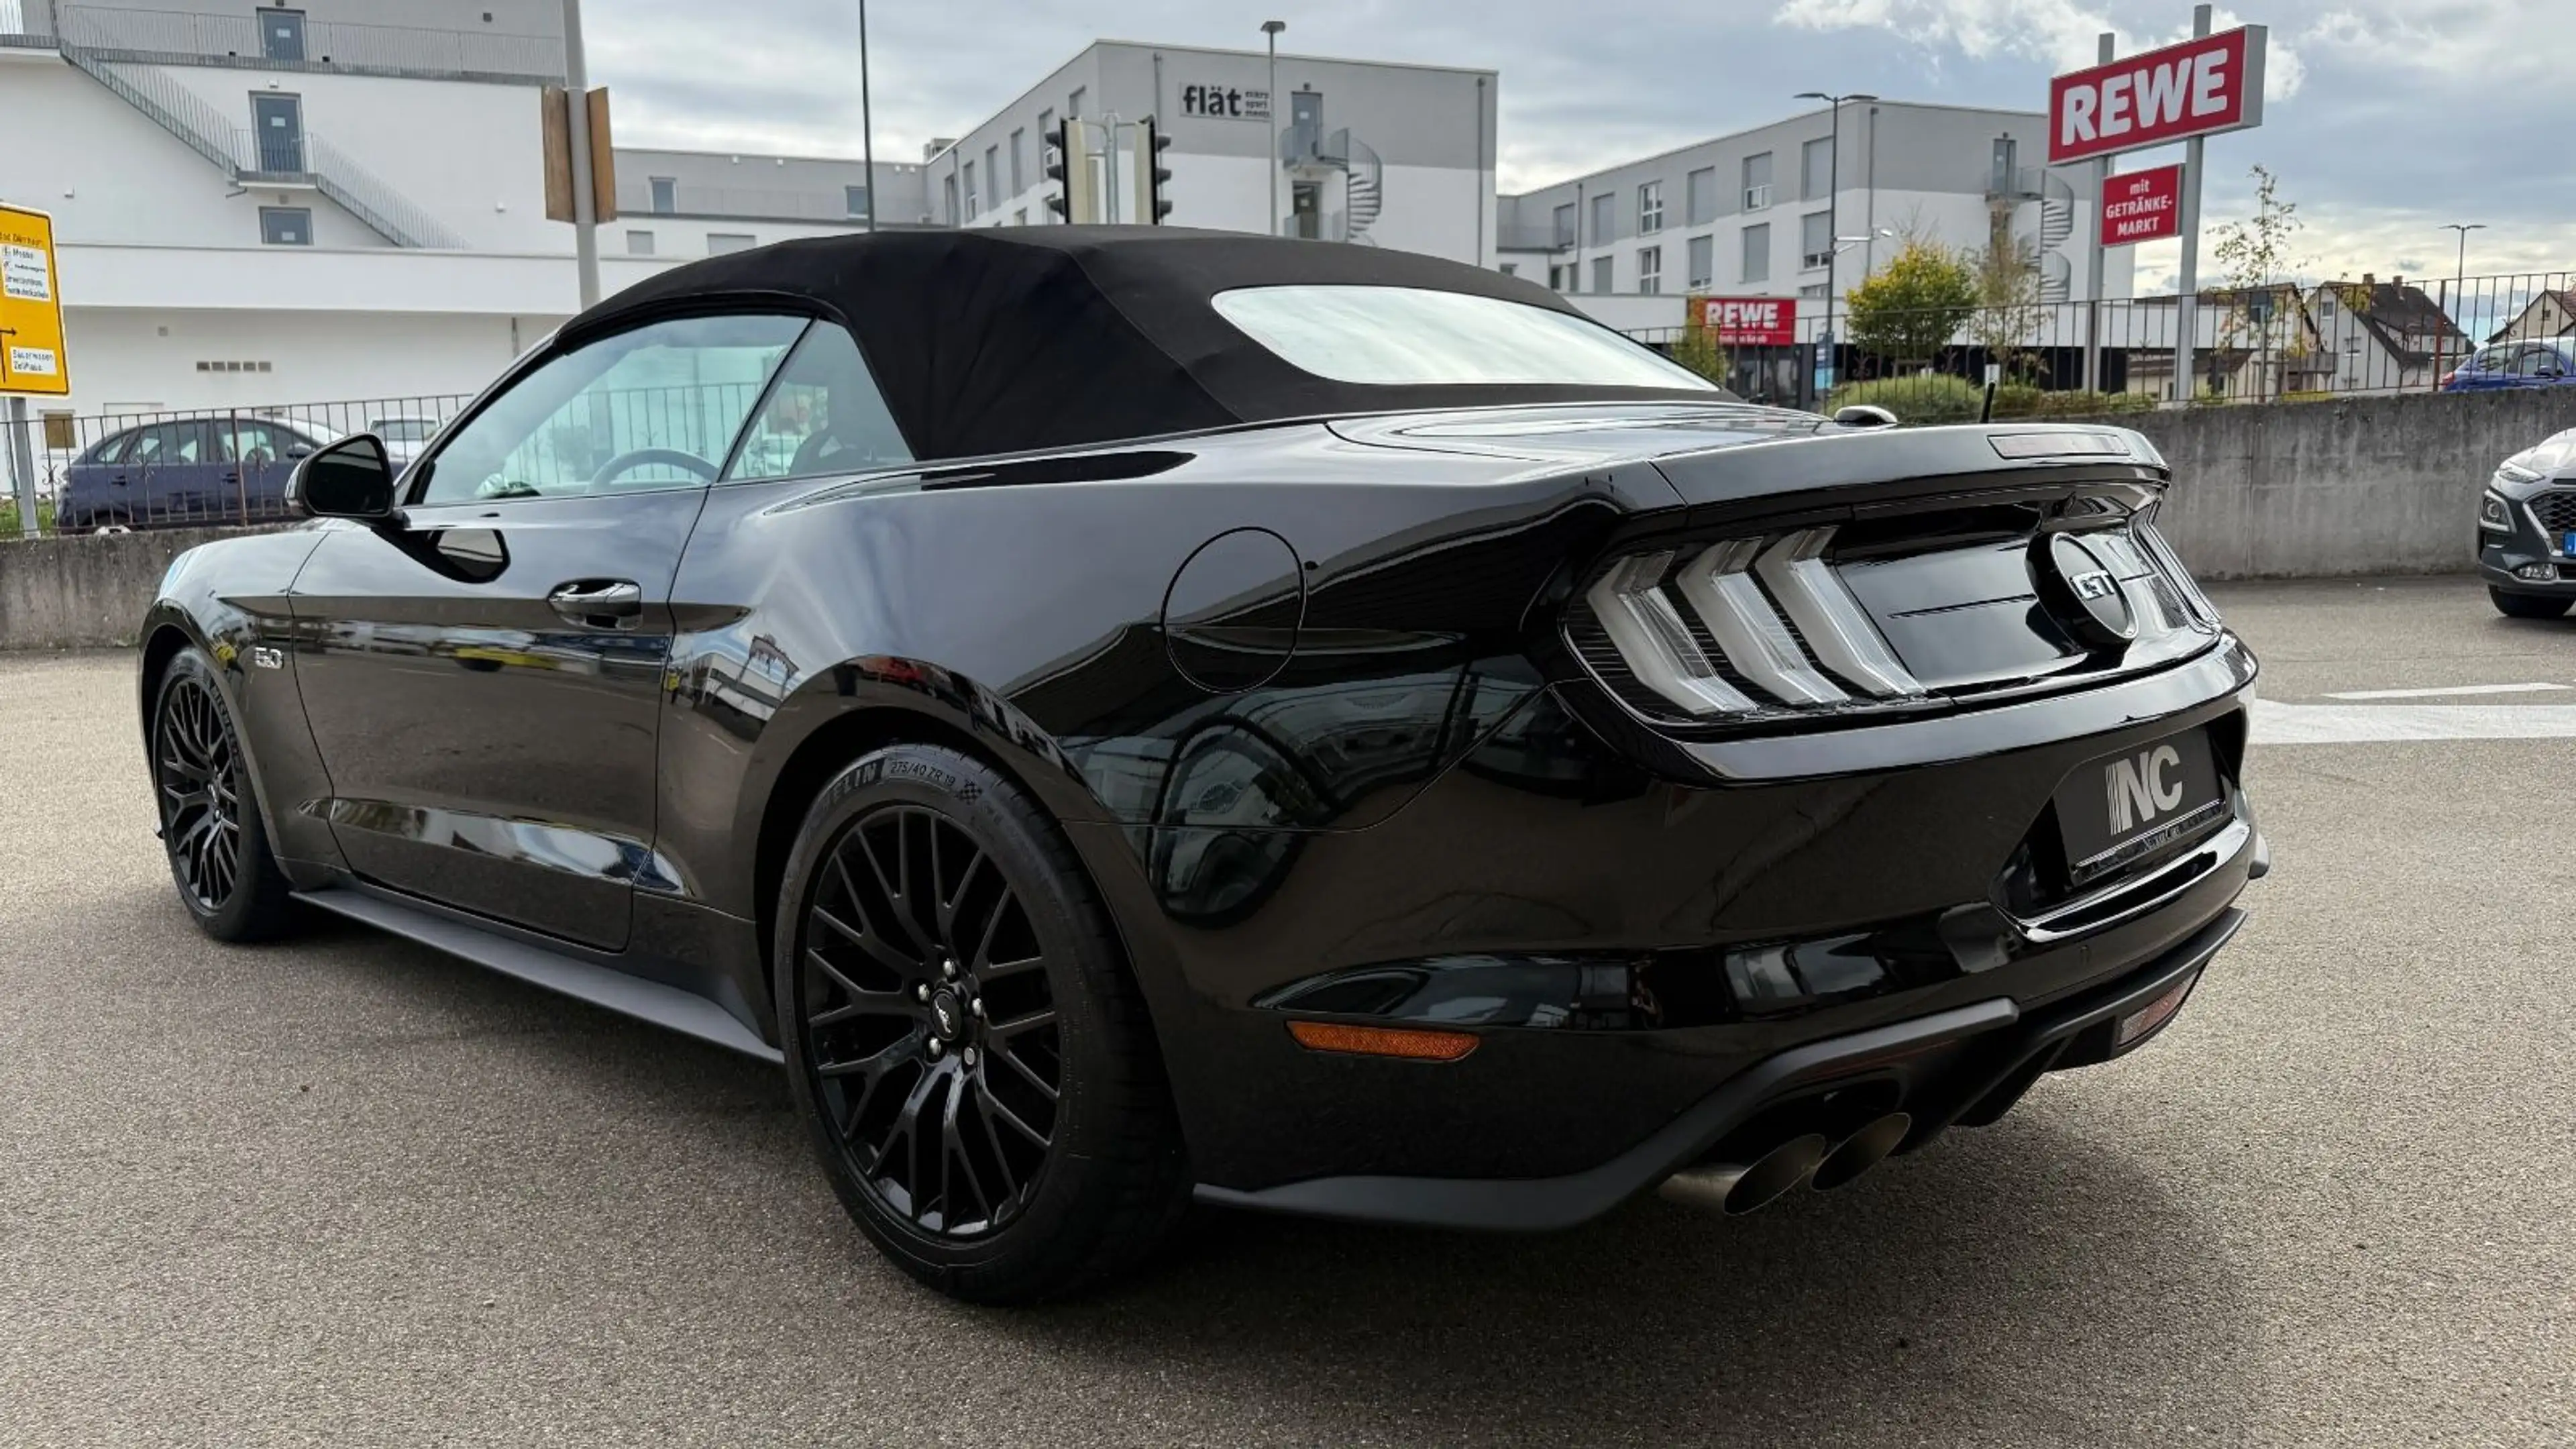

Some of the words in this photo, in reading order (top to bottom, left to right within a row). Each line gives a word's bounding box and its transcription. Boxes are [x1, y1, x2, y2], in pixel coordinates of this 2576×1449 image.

[1183, 85, 1242, 116] flät
[2061, 48, 2229, 146] REWE
[2129, 178, 2150, 195] mit
[2106, 194, 2173, 219] GETRÄNKE-
[2116, 216, 2159, 236] MARKT
[1706, 302, 1779, 328] REWE
[2071, 570, 2114, 601] GT
[890, 760, 927, 775] 275/40
